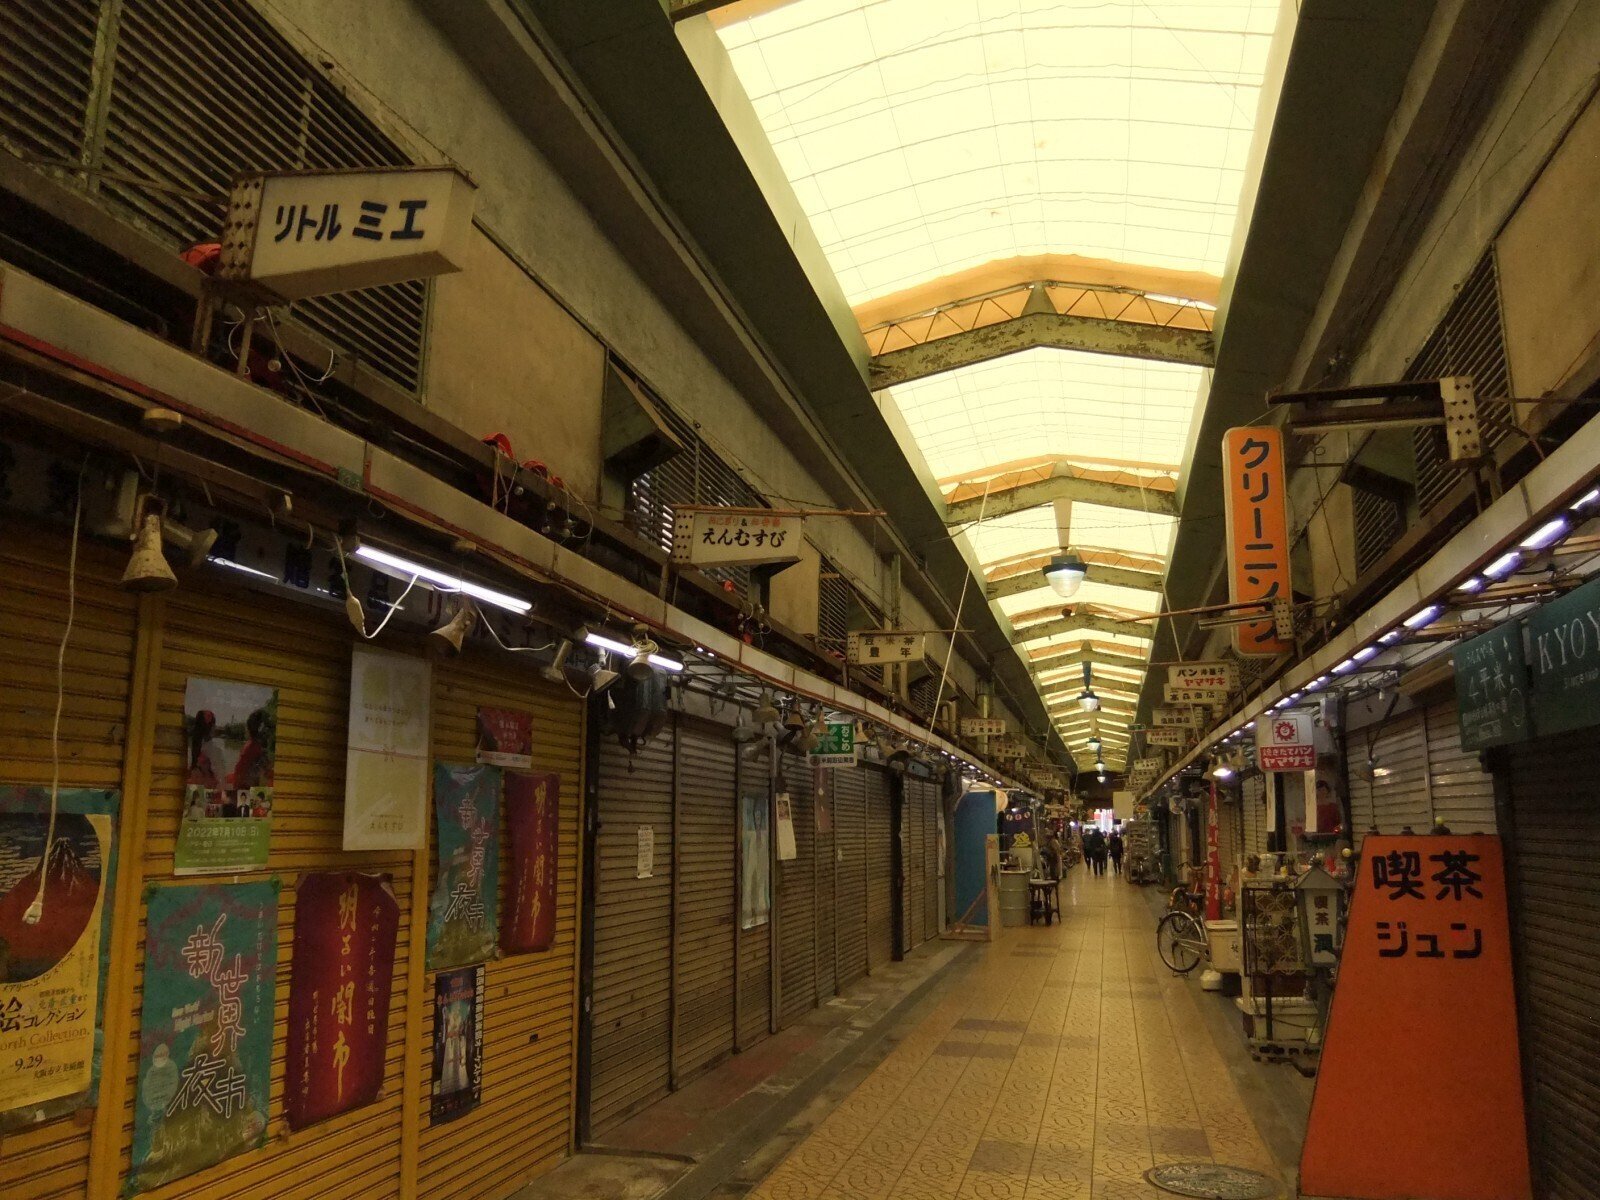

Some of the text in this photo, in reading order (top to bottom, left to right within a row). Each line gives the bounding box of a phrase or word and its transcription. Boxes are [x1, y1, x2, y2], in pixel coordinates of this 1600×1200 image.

[702, 526, 787, 548] えんむすび
[1183, 677, 1226, 687] ヤマザキ
[1262, 756, 1313, 768] ヤマザキ
[1372, 850, 1483, 901] 喫茶
[1375, 921, 1483, 960] ジュン
[166, 912, 249, 1119] 新世界夜市
[14, 1054, 44, 1072] 9.29
